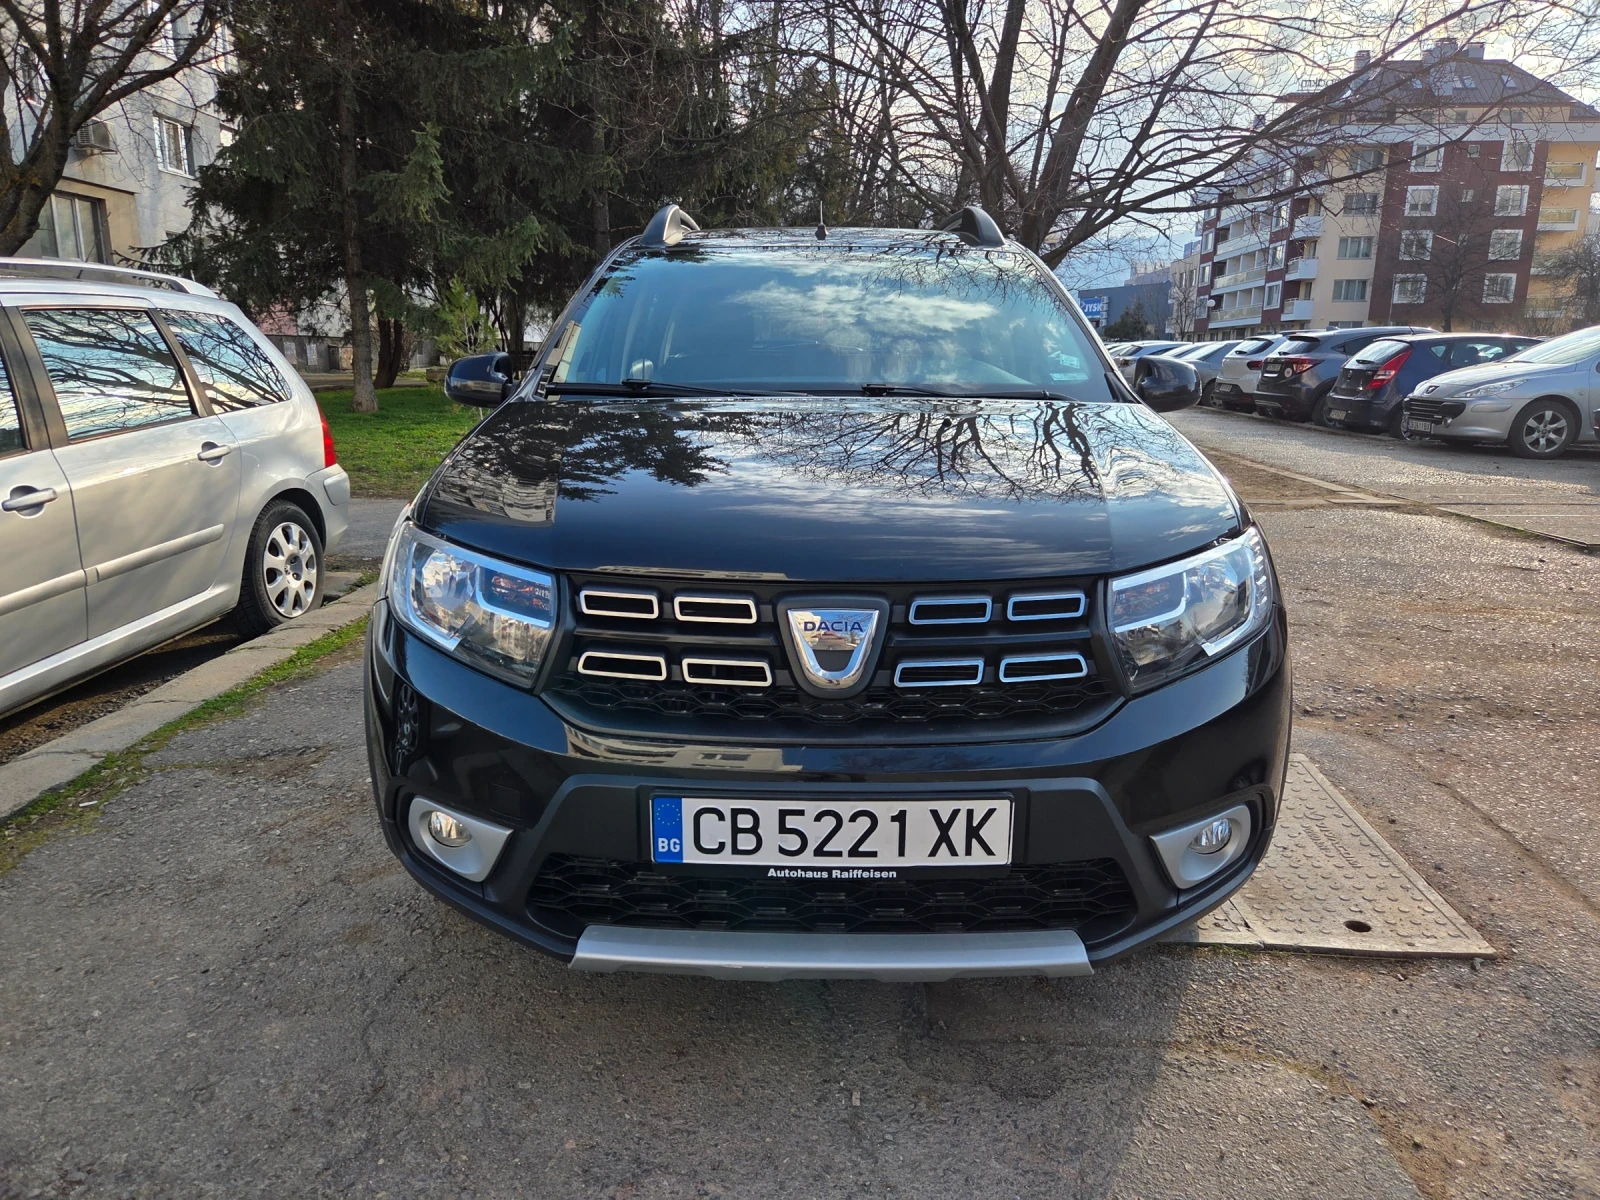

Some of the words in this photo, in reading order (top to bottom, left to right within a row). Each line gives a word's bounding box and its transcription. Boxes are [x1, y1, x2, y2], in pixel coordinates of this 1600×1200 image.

[803, 621, 864, 632] DACIA
[693, 807, 763, 856] CB
[777, 808, 907, 858] 5221
[927, 807, 998, 857] XK
[658, 837, 681, 853] BG
[767, 868, 829, 878] Autohaus
[832, 869, 897, 879] Raiffeisen
